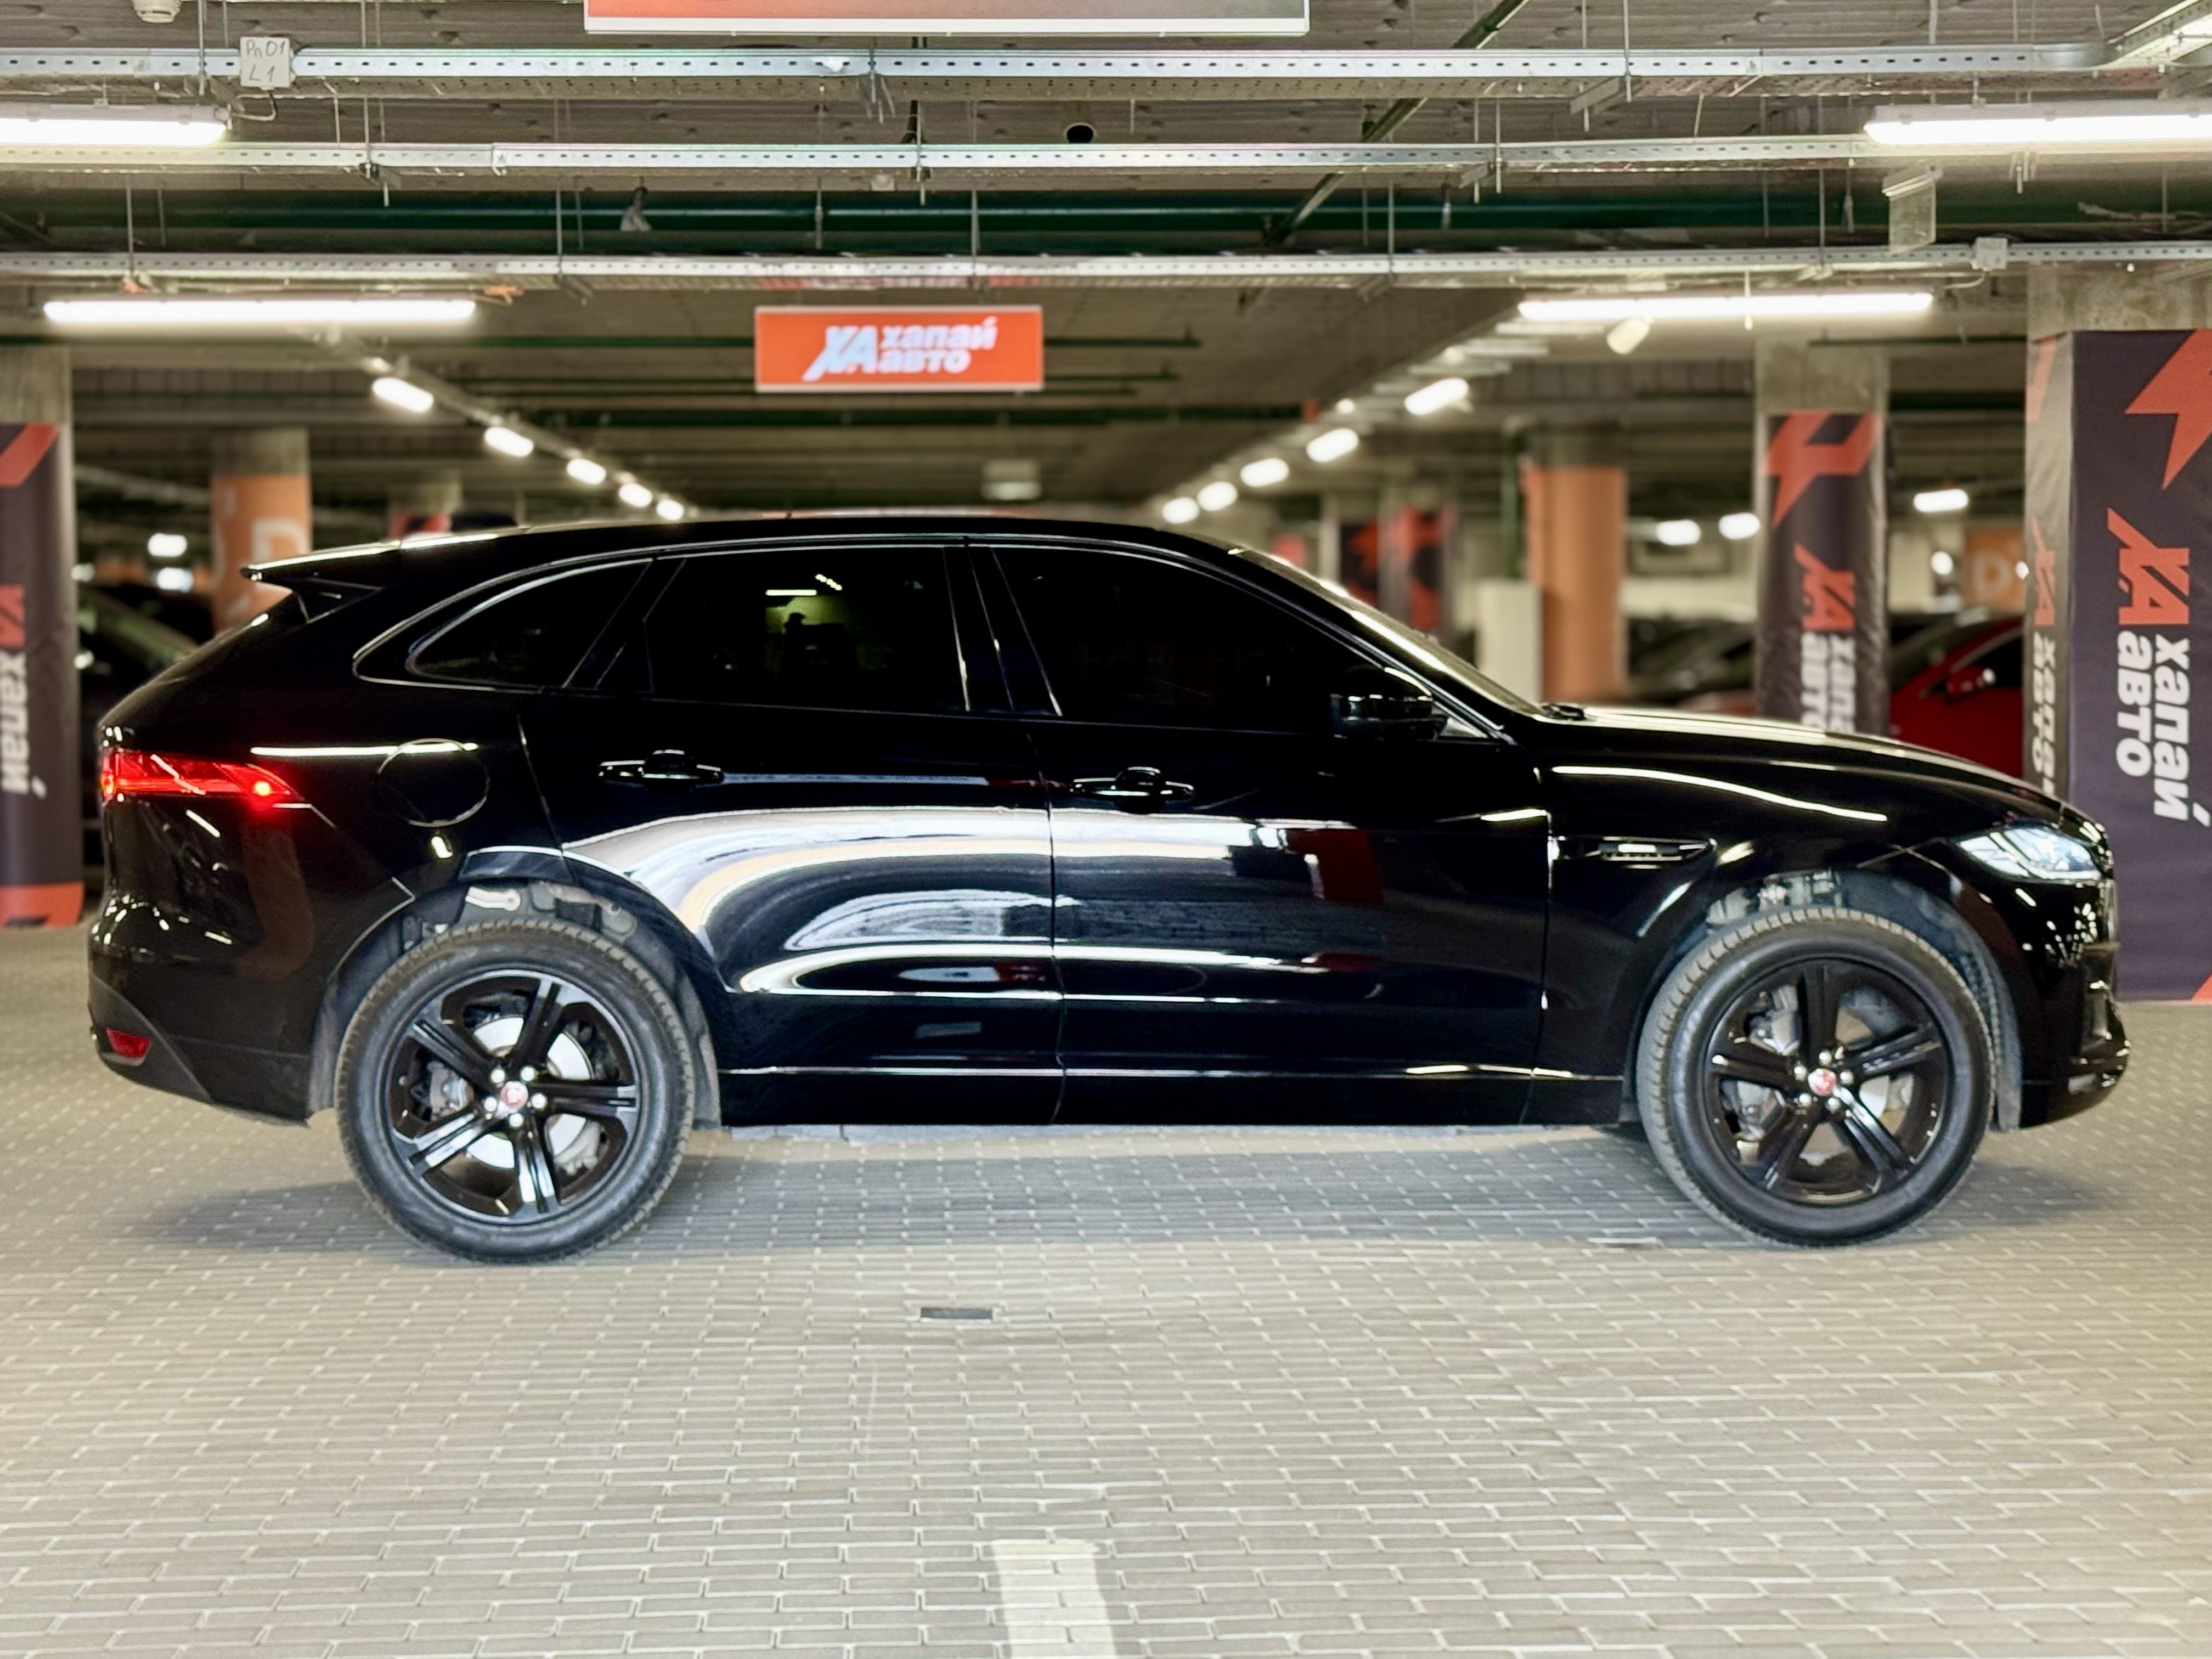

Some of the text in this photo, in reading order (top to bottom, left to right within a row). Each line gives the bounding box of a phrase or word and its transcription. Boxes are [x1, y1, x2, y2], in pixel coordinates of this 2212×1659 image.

[878, 348, 972, 374] авто
[879, 315, 998, 350] хапай
[2115, 630, 2152, 777] авто
[2153, 633, 2211, 827] хапай
